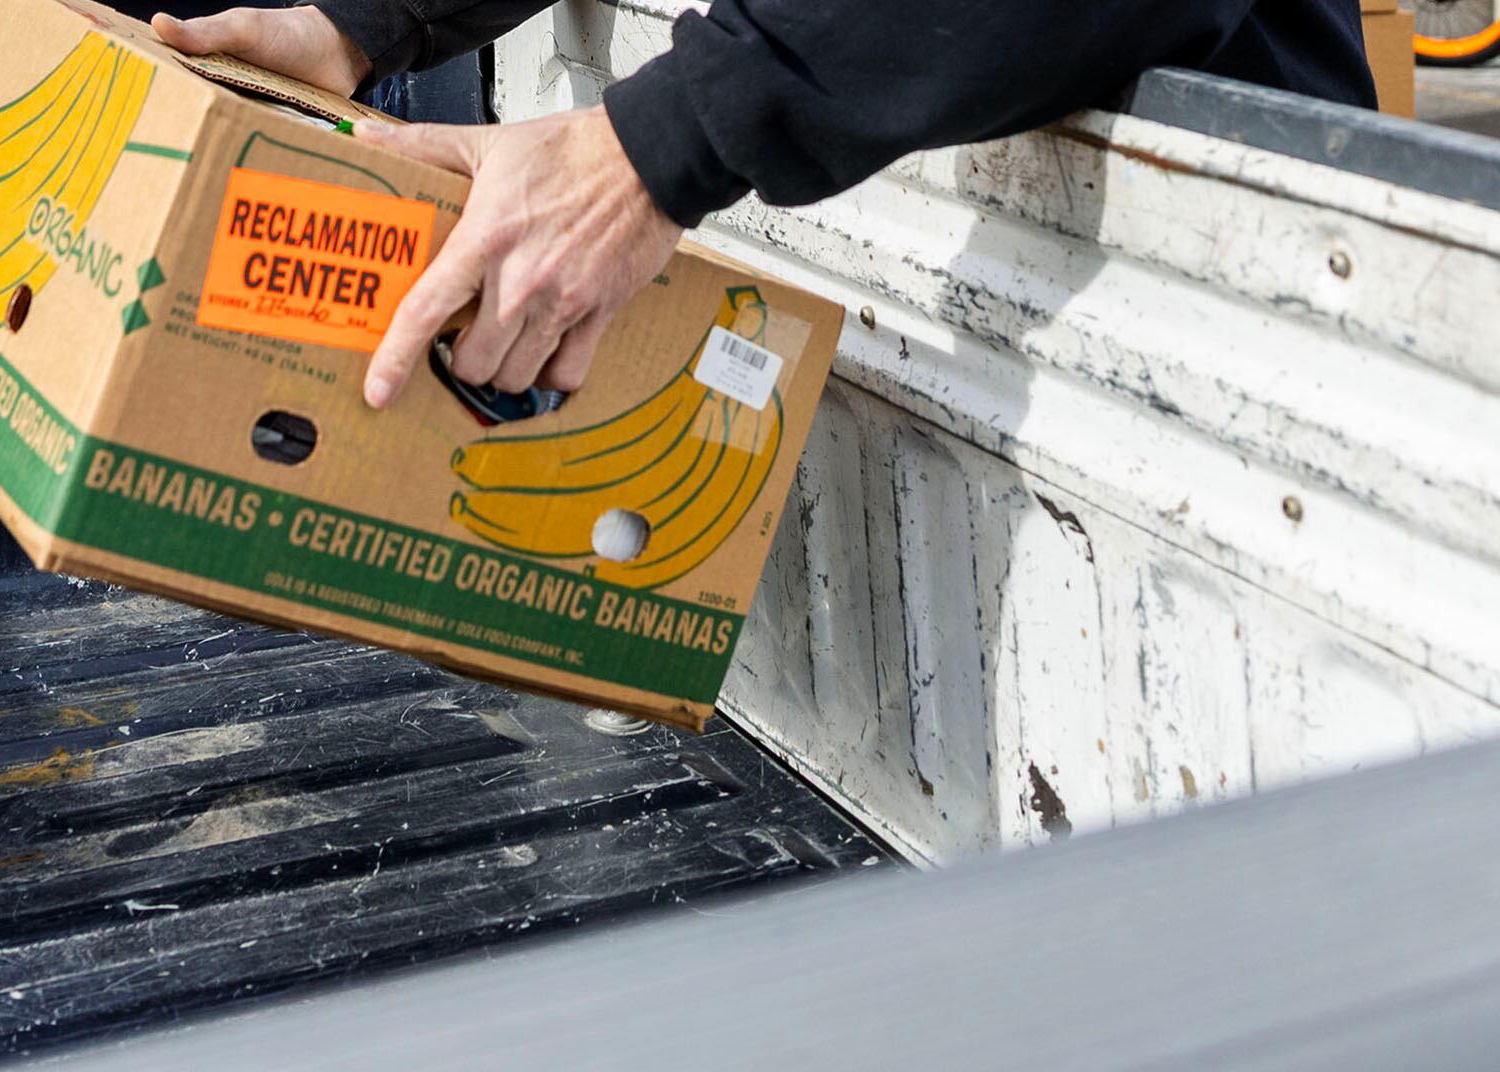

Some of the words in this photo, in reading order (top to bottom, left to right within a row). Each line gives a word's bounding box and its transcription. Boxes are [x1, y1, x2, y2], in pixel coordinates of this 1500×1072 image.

[29, 196, 124, 298] ORGANIC
[229, 197, 420, 267] RECLAMATION
[243, 251, 381, 310] CENTER
[10, 391, 76, 475] ORGANIC
[85, 449, 262, 531] BANANAS
[289, 507, 452, 584] CERTIFIED
[455, 553, 593, 620] ORGANIC
[595, 590, 734, 655] BANANAS
